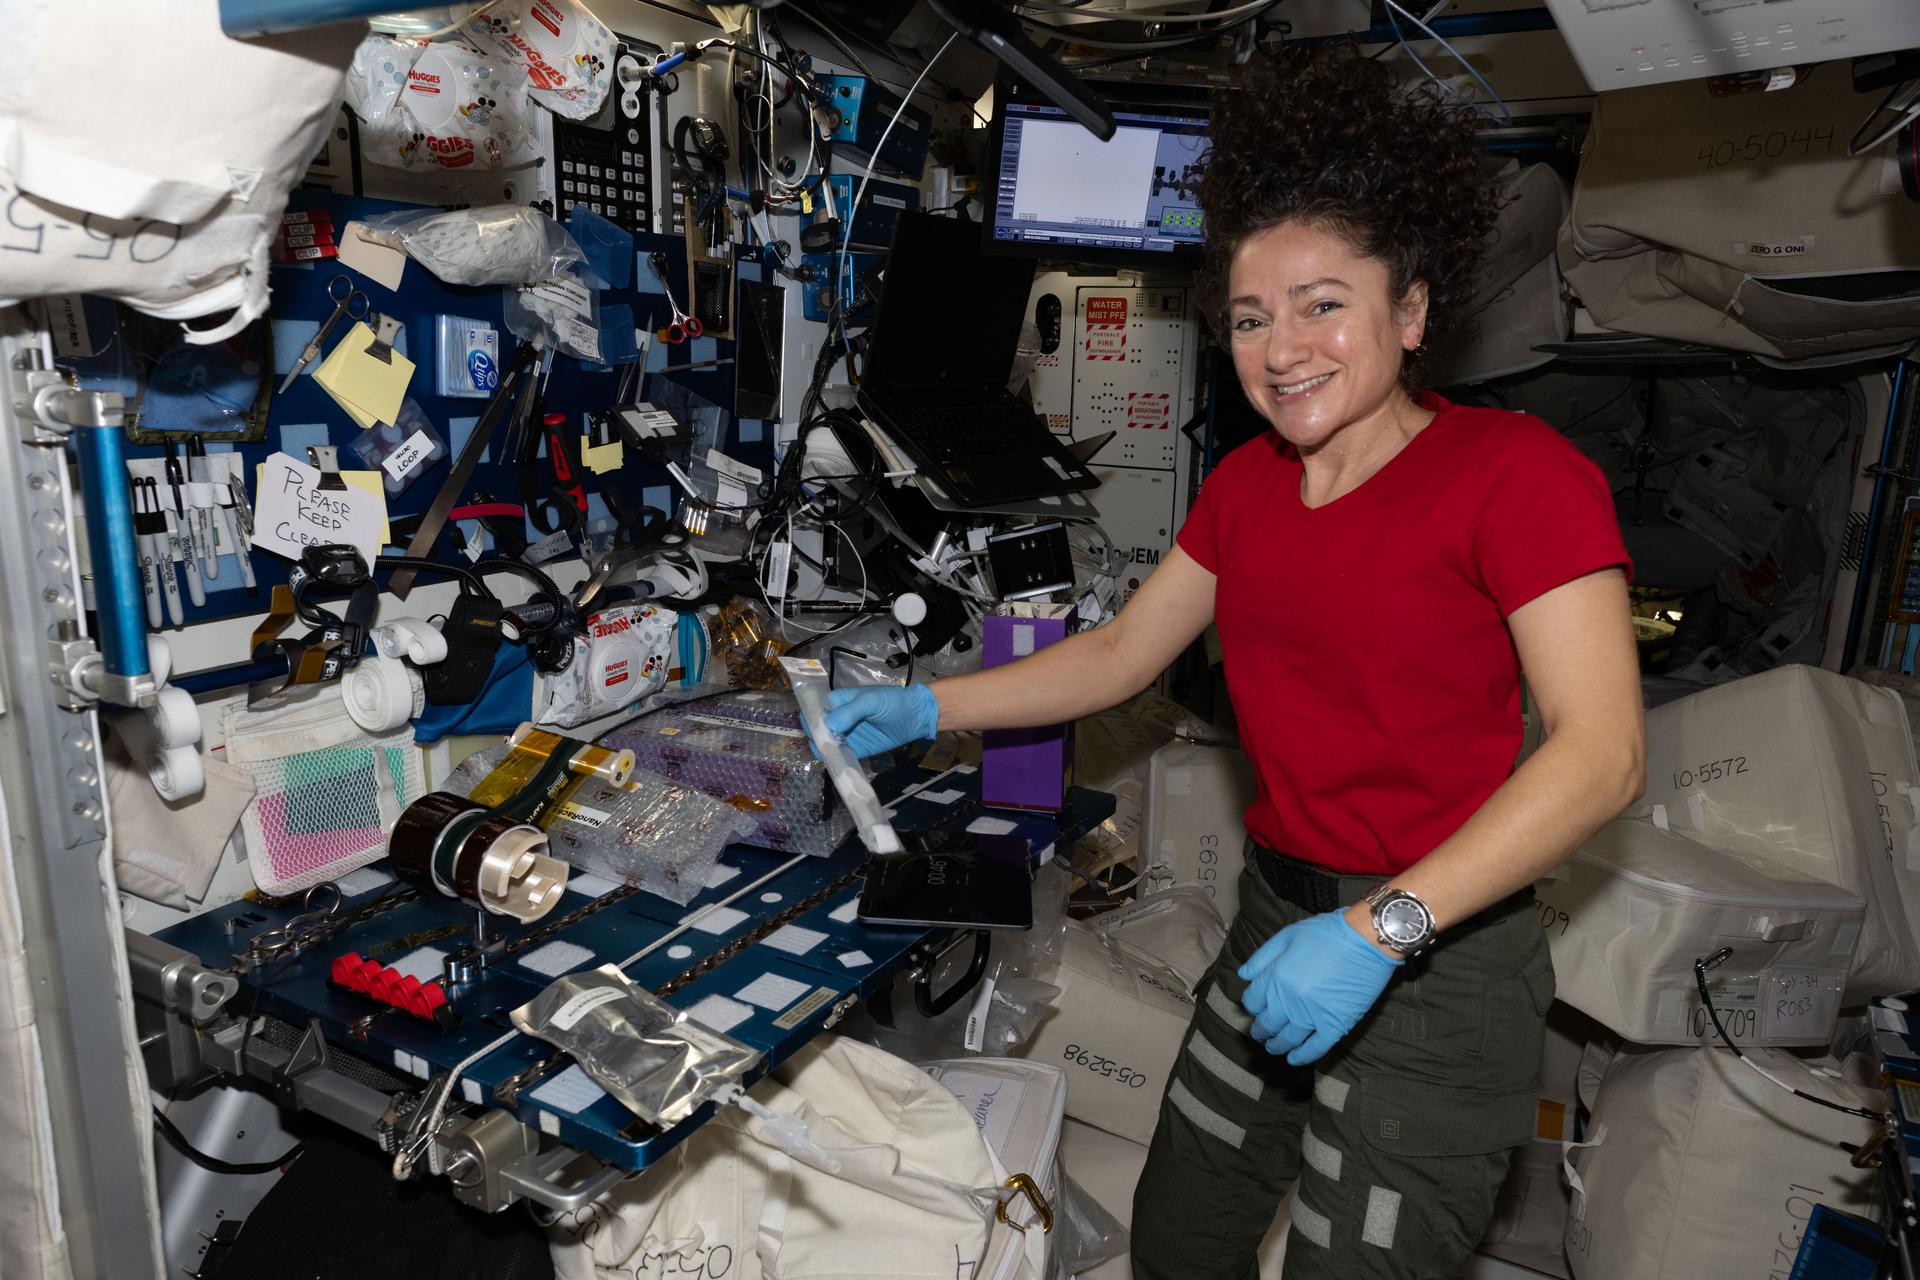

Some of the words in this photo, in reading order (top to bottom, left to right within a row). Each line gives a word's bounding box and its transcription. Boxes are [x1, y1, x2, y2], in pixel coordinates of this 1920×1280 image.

[538, 0, 565, 22] UGGIES
[408, 69, 441, 83] HUGGIES
[426, 135, 474, 154] GGIES
[284, 213, 306, 222] CLIP
[291, 225, 313, 234] CLIP
[289, 236, 312, 246] CLIP
[297, 248, 319, 258] CLIP
[1750, 245, 1771, 255] ZERO
[1773, 246, 1783, 255] G
[1092, 300, 1123, 310] WATER
[1088, 311, 1108, 320] MIST
[1109, 311, 1126, 320] PFE
[1097, 339, 1115, 347] FIRE
[1134, 407, 1163, 415] BREATHING
[397, 450, 419, 473] LOOP
[283, 466, 351, 522] PLEASE
[298, 500, 342, 532] KEEP
[593, 616, 631, 639] HUGGIE
[556, 641, 572, 669] PETZL
[605, 659, 629, 673] HUGGIES
